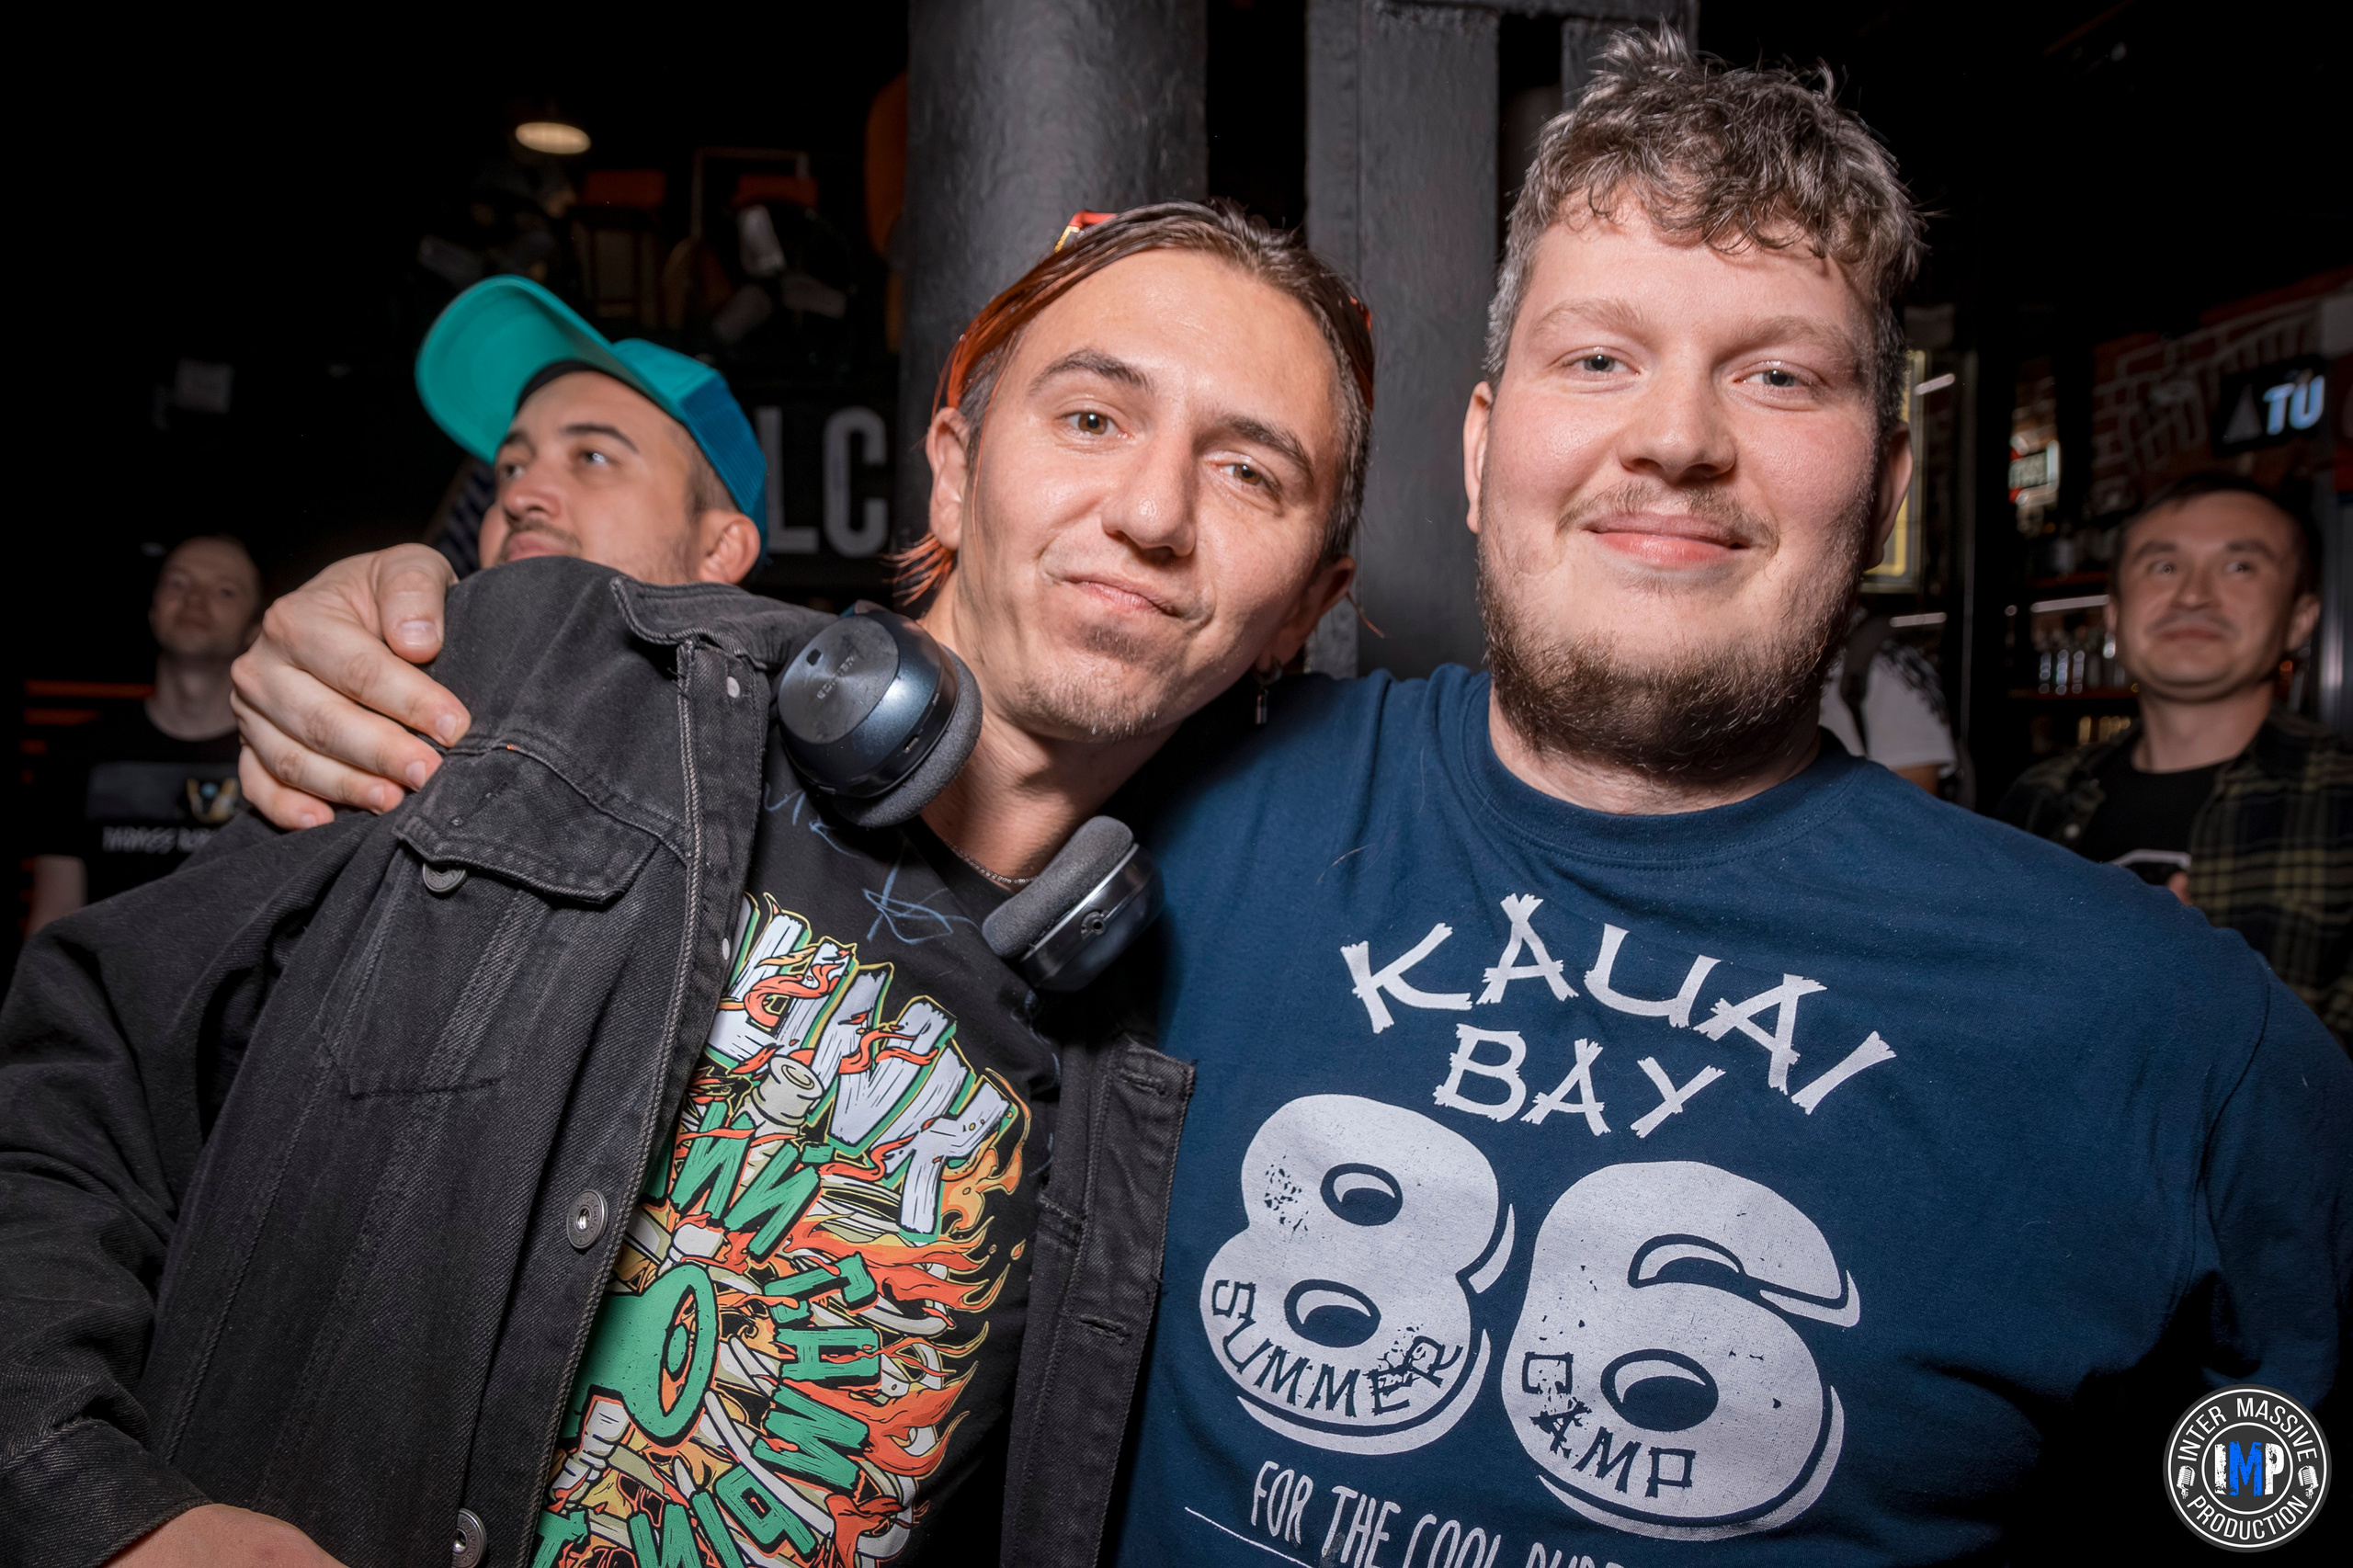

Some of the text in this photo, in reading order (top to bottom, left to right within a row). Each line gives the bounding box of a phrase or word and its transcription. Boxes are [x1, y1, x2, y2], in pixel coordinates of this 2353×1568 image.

[1340, 892, 1897, 1116] KAUAI
[1433, 1023, 1726, 1138] BAY
[1199, 1093, 1861, 1541] 86
[1211, 1278, 1463, 1417] SUMMER
[1522, 1351, 1696, 1498] CAMP
[1251, 1460, 1313, 1544] FOR
[1321, 1485, 1402, 1568] THE
